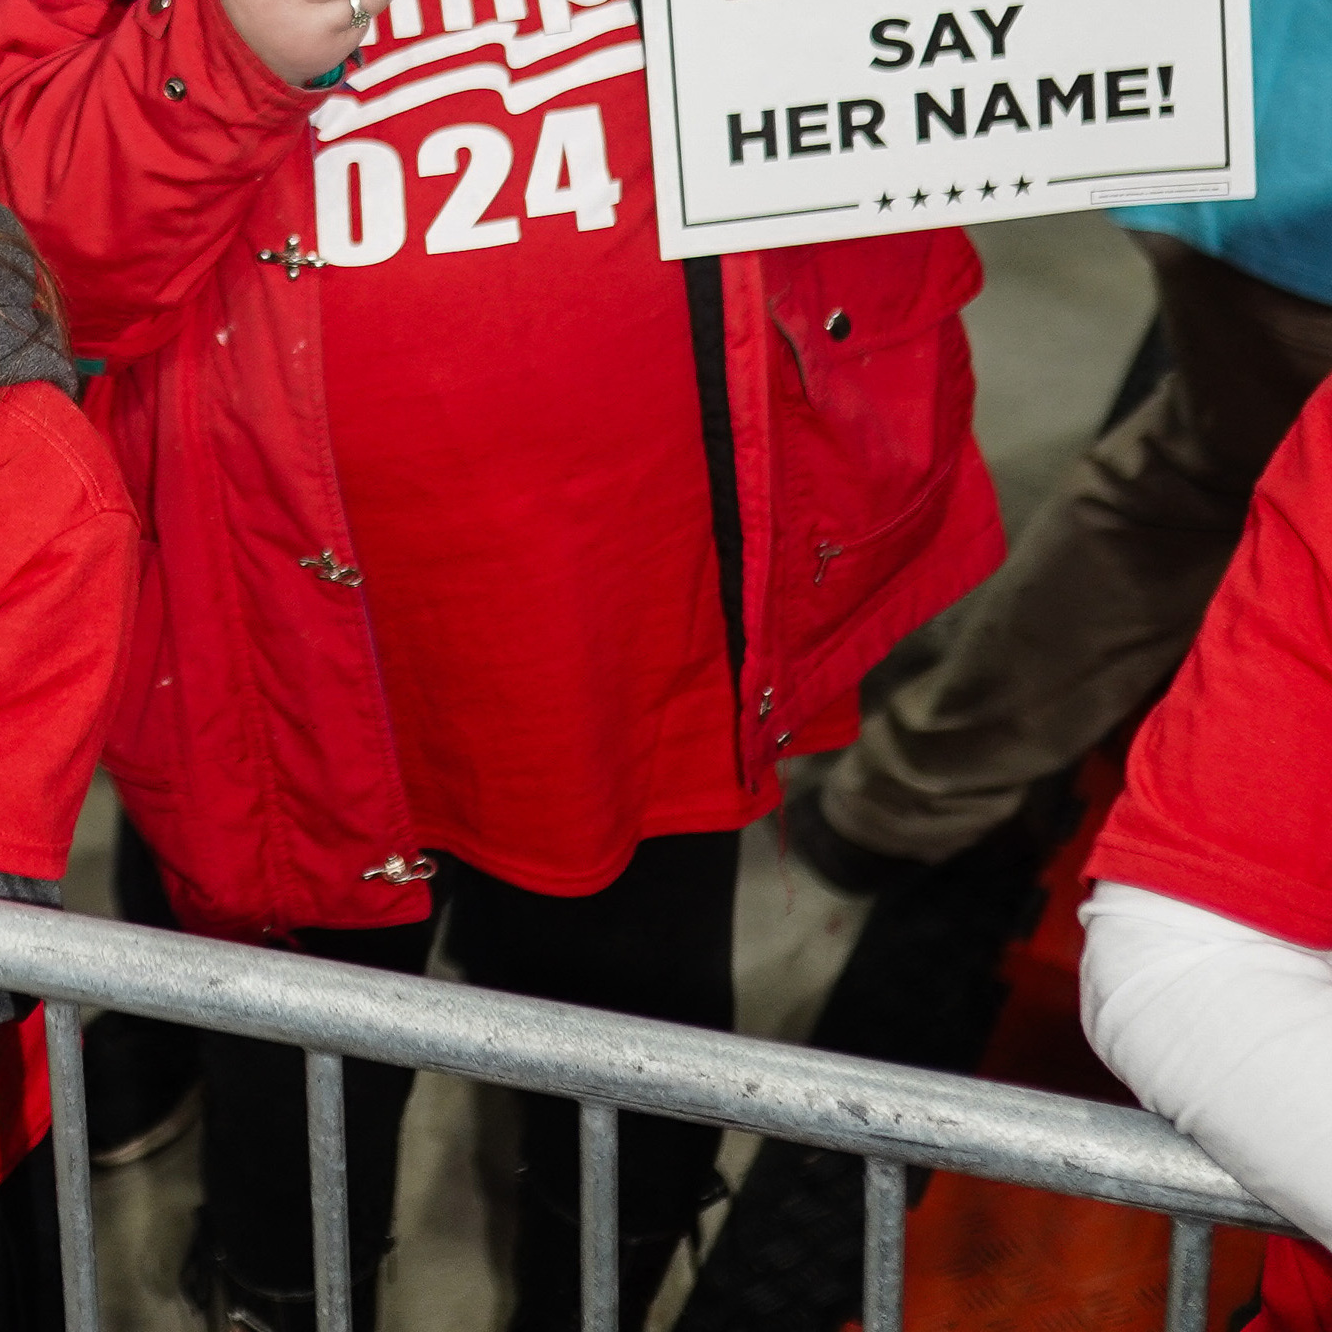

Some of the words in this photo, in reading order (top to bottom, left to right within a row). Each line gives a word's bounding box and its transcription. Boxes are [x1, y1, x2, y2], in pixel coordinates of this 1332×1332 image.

[868, 4, 1024, 72] SAY
[727, 97, 888, 166] HER
[914, 65, 1176, 145] NAME!
[314, 103, 622, 267] 024
